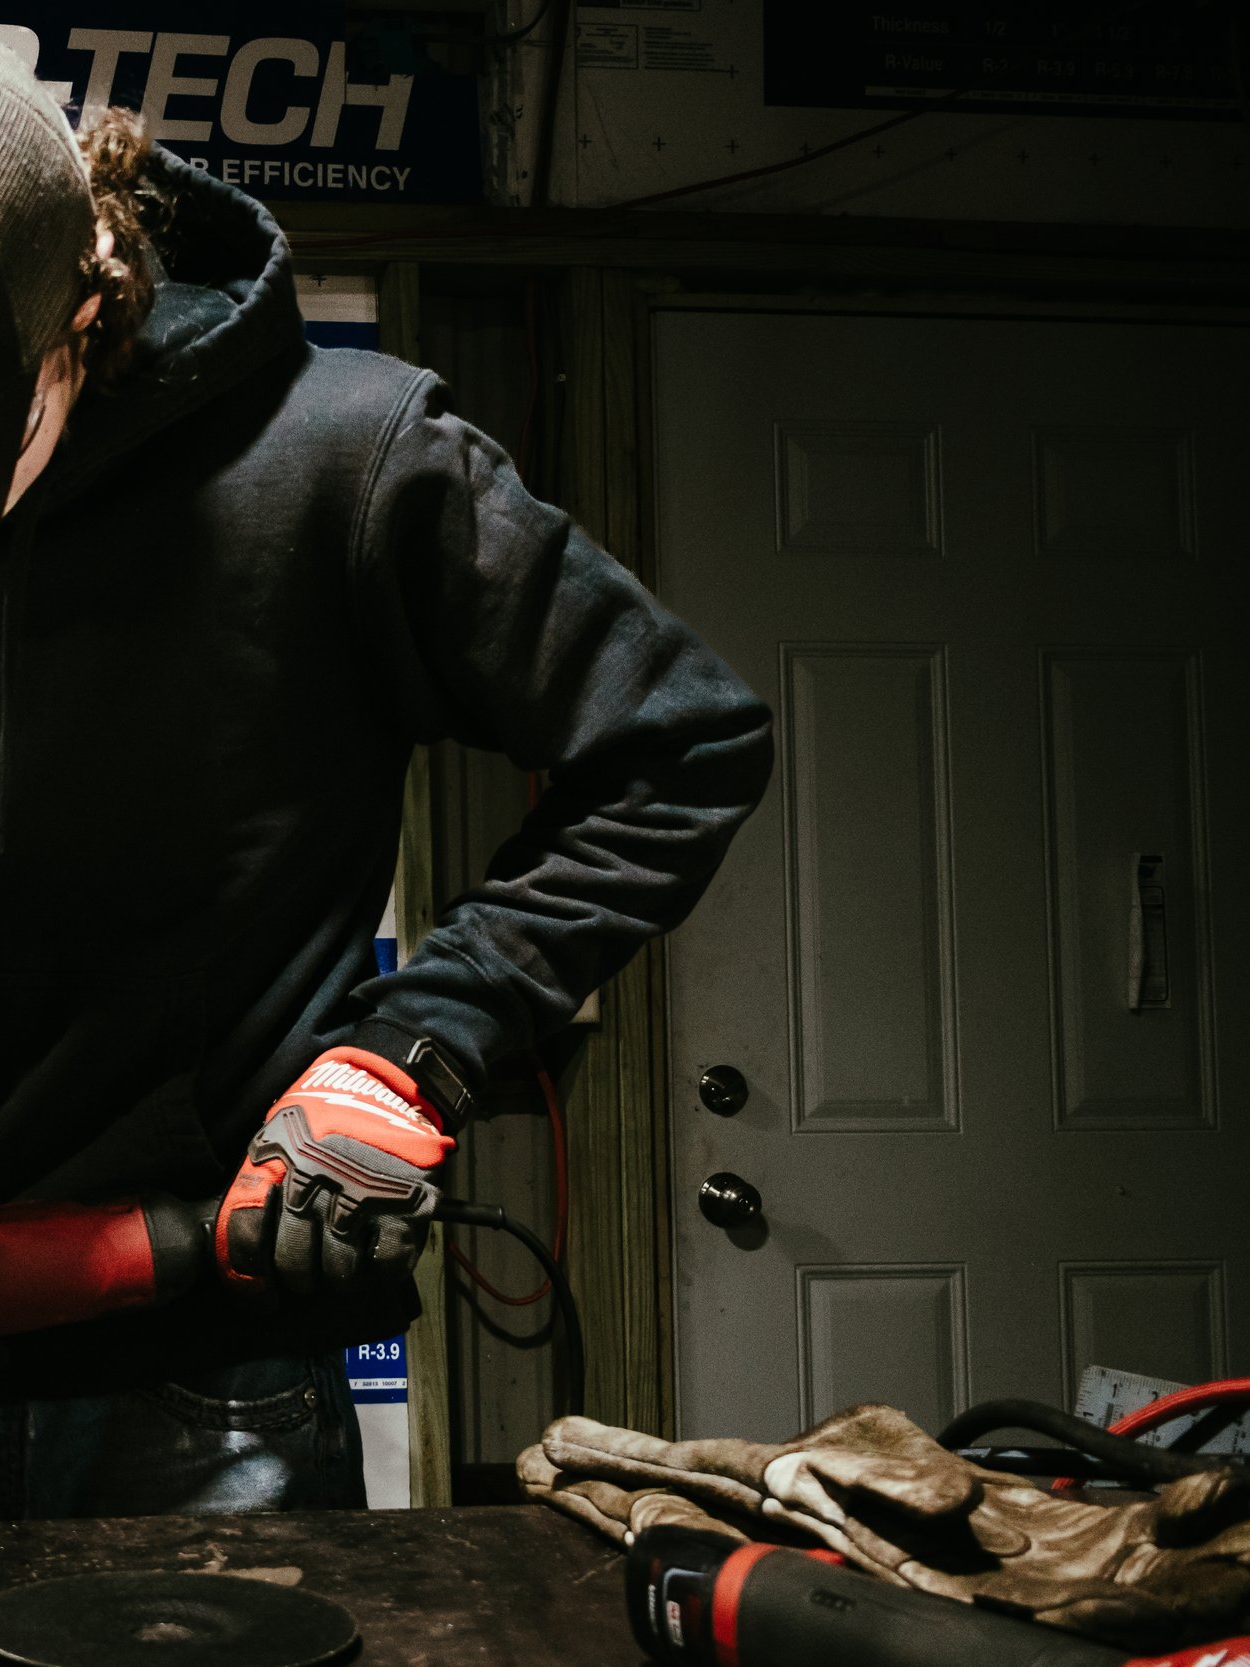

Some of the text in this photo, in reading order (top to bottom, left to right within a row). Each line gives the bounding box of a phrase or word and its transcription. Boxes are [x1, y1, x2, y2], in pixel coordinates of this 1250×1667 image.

[871, 16, 950, 33] Thickness
[885, 54, 943, 72] R-Value
[222, 159, 412, 191] EFFICIENCY
[358, 1343, 400, 1360] R-3.9
